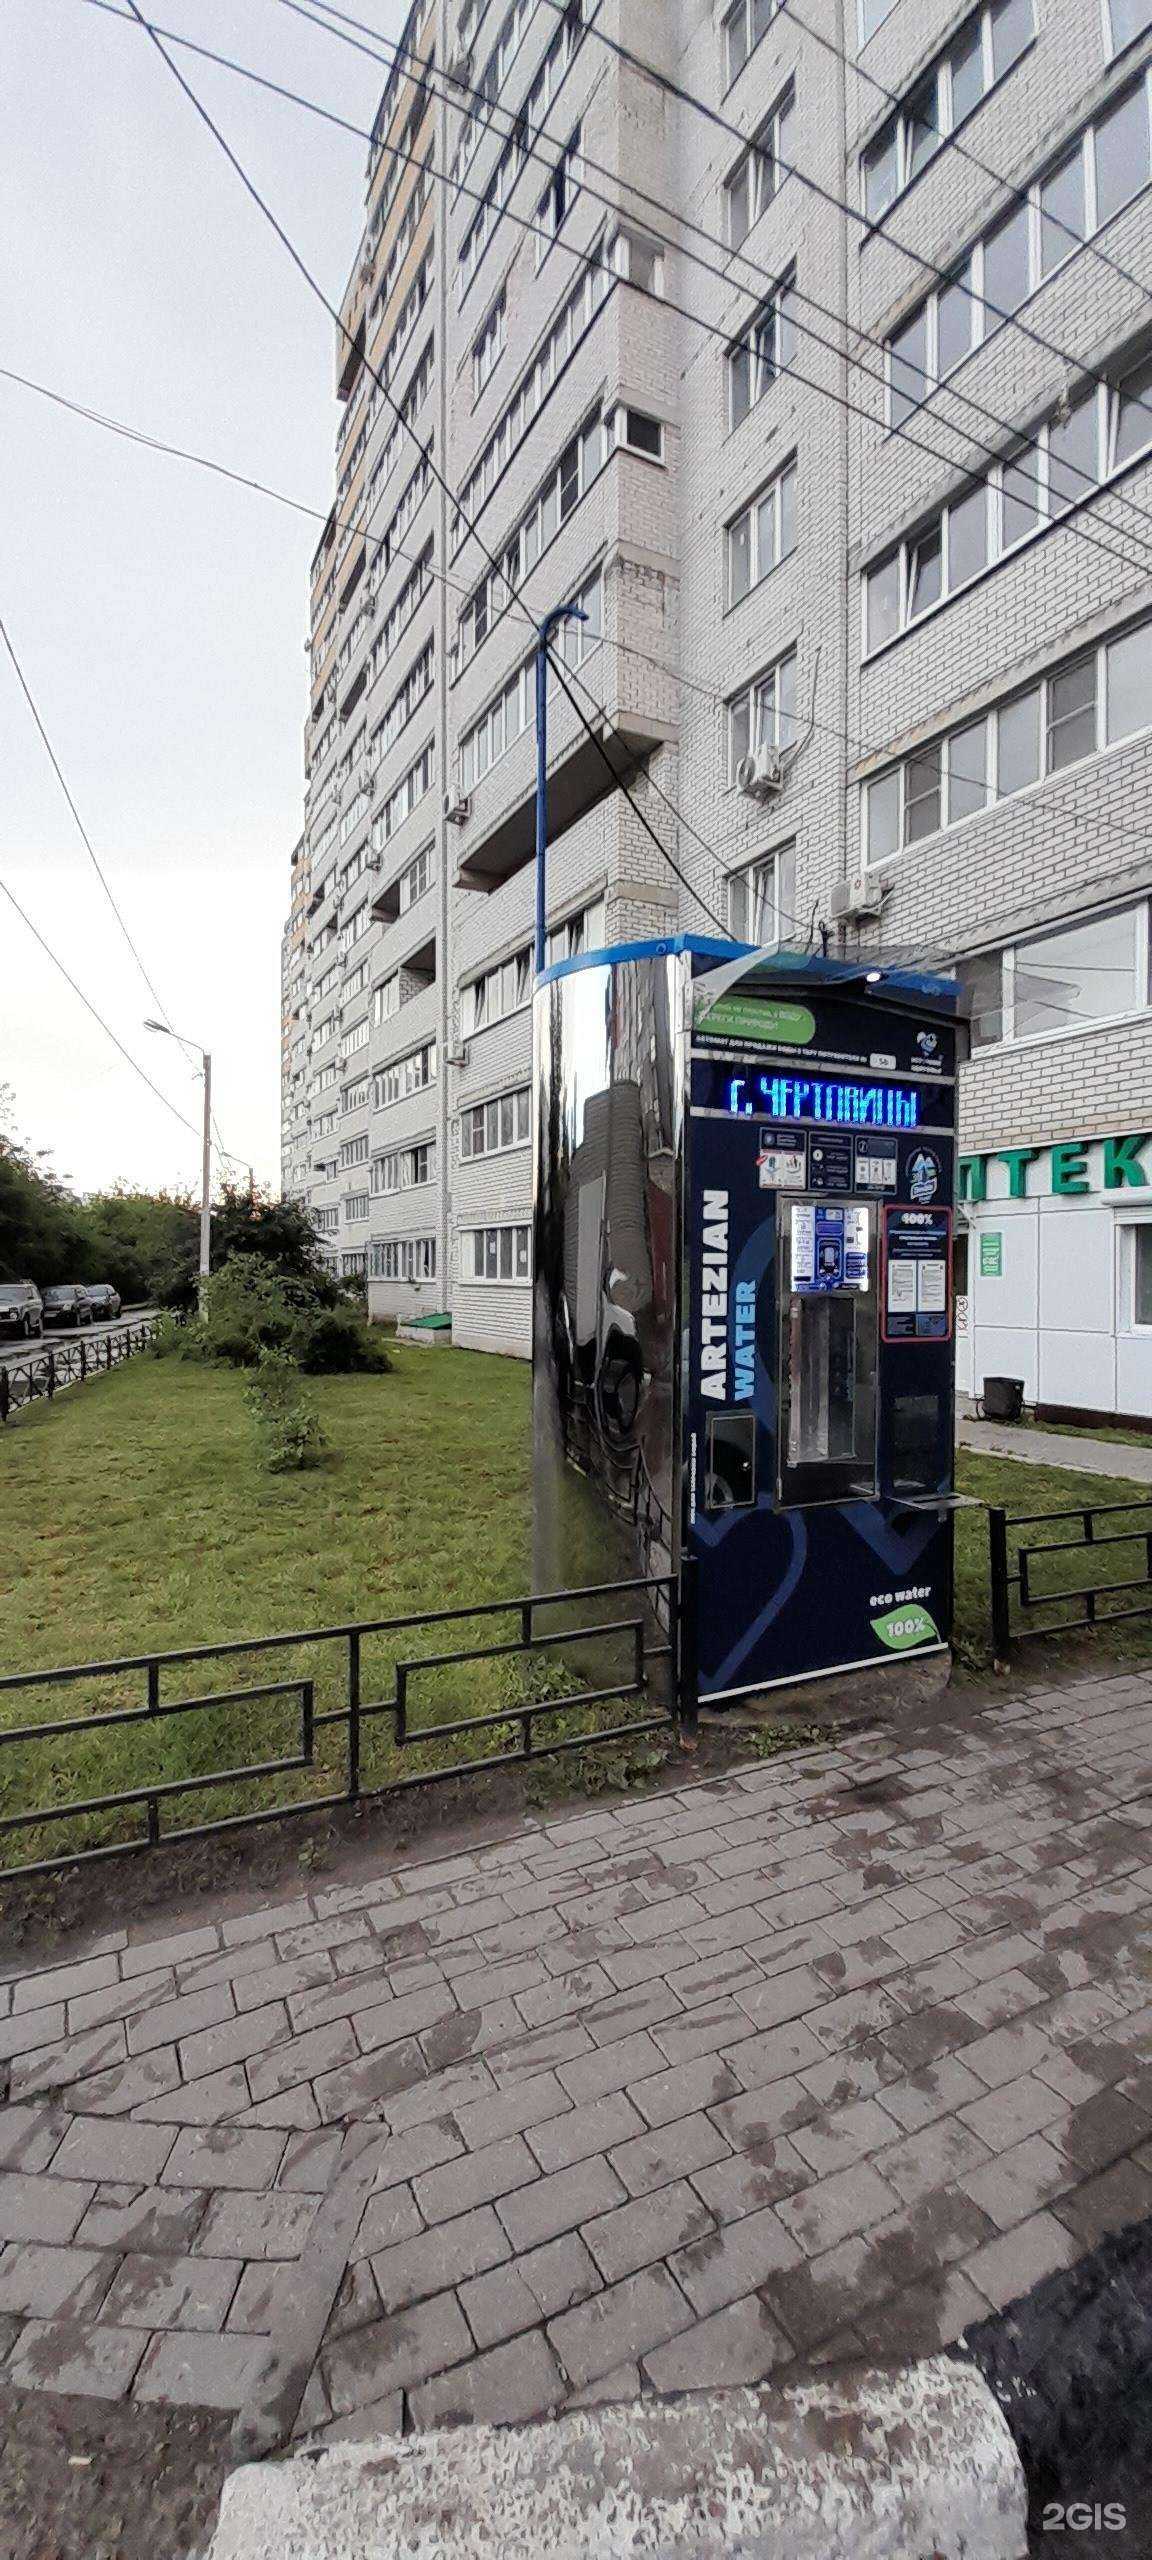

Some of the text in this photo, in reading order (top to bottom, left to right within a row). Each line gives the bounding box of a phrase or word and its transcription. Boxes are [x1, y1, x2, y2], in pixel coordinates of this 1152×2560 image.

[701, 1190, 729, 1400] ARTEZIAN
[734, 1279, 756, 1401] WATER
[869, 1586, 931, 1607] eco water
[886, 1617, 927, 1637] 100%
